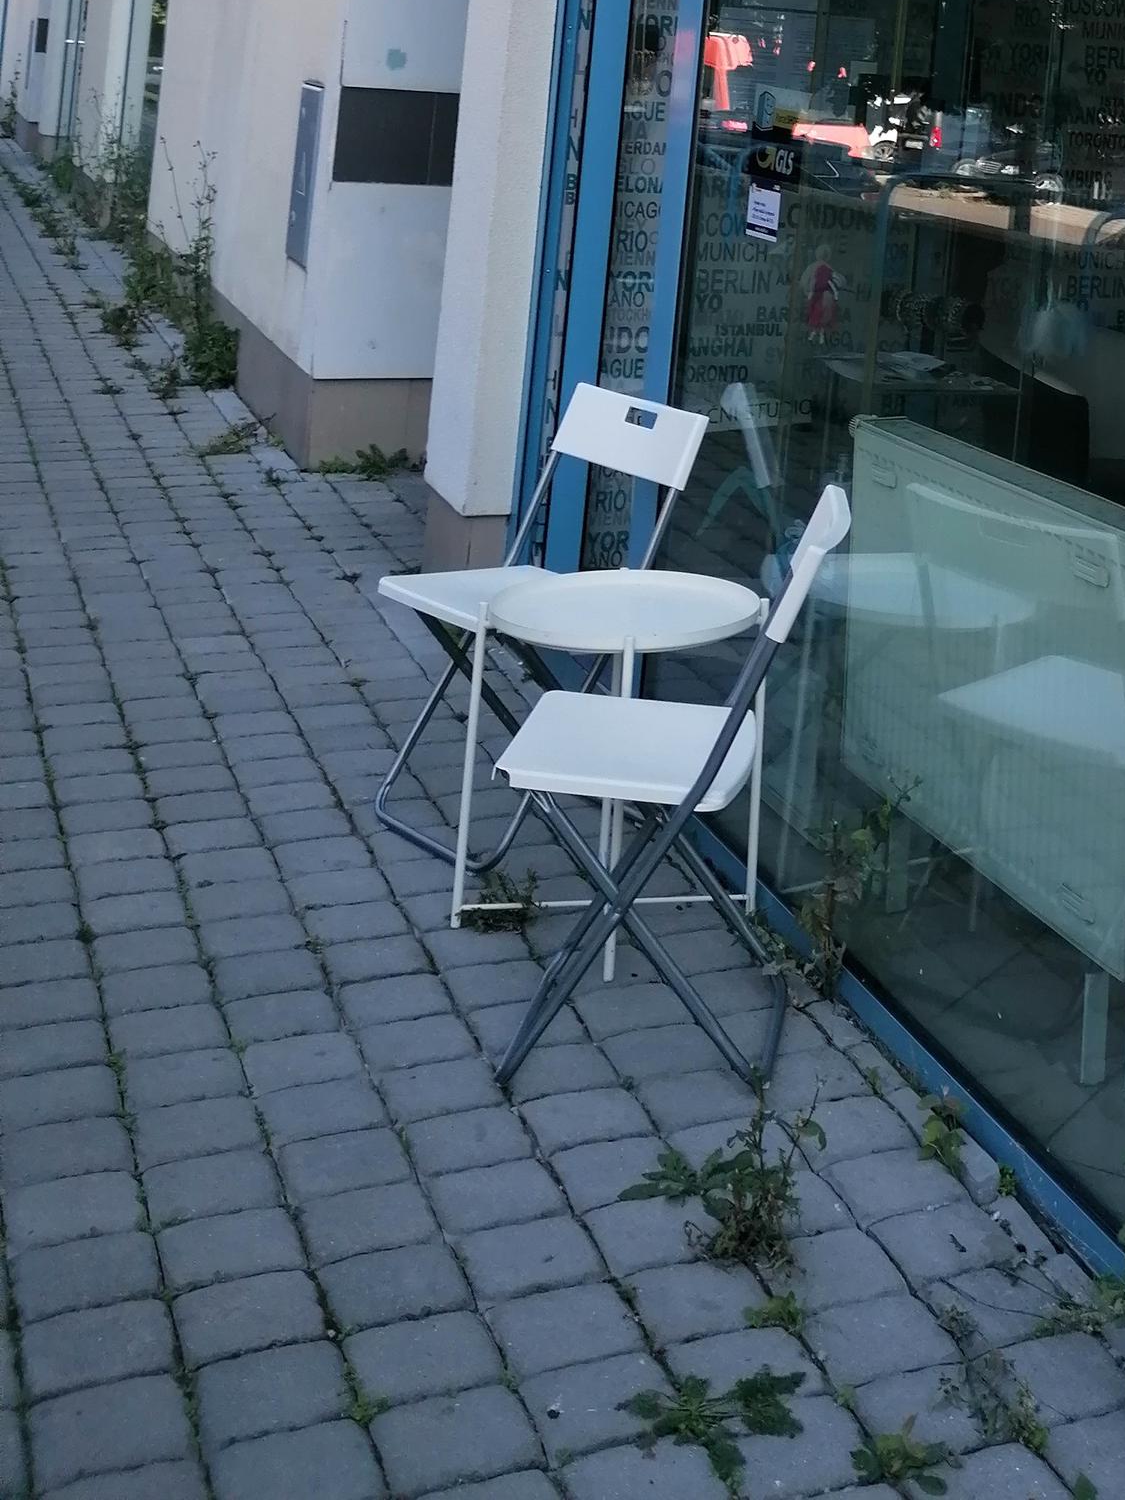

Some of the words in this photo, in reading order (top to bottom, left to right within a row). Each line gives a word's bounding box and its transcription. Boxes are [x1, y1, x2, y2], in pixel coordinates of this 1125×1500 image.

[775, 148, 795, 176] GLS
[617, 230, 648, 253] RIO
[697, 268, 771, 294] BERLIN
[715, 323, 783, 337] ISTANBUL
[595, 489, 625, 513] RIO
